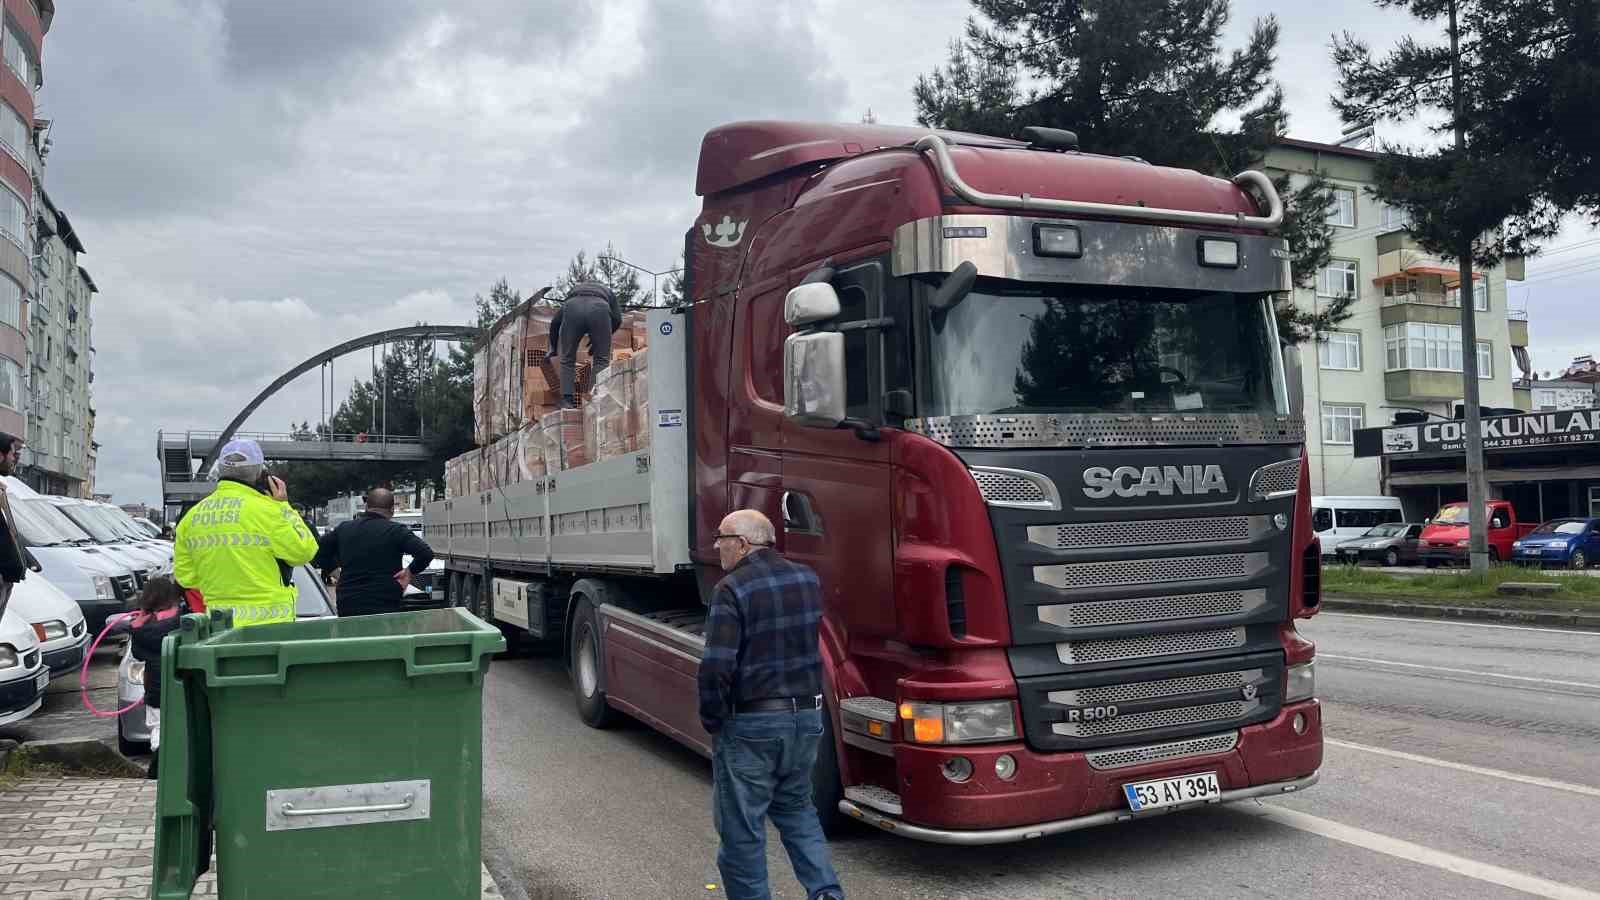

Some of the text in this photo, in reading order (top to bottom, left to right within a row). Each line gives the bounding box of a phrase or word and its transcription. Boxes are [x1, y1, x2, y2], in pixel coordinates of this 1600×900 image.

[1424, 411, 1600, 441] COKUNLA
[1082, 465, 1228, 499] SCANIA
[1068, 705, 1118, 722] R 500
[1136, 785, 1159, 805] 53
[1163, 780, 1182, 801] AY
[1186, 776, 1218, 798] 394
